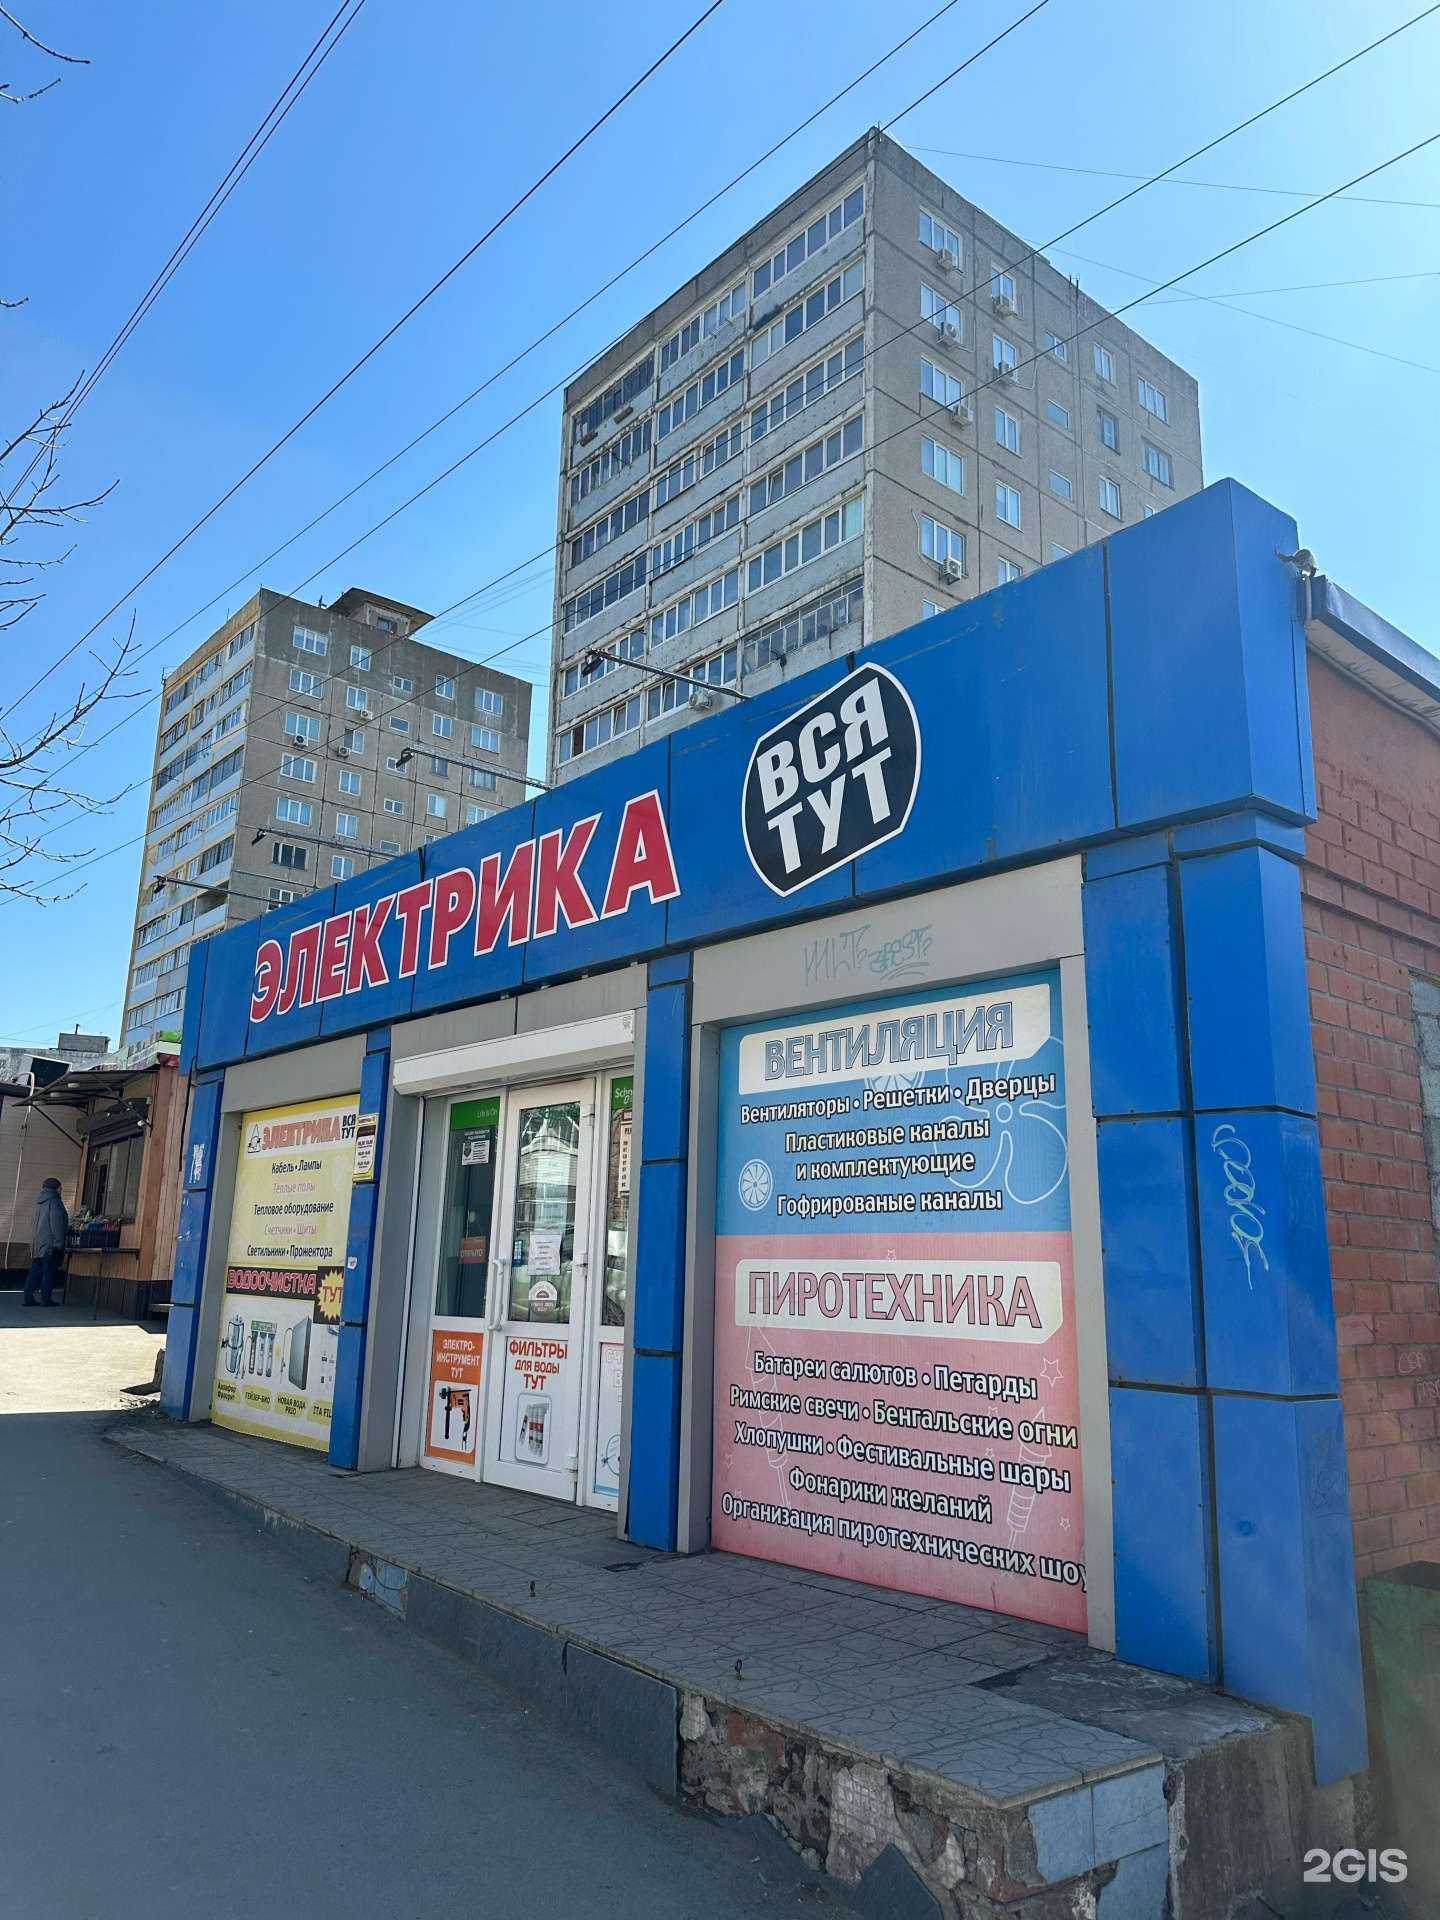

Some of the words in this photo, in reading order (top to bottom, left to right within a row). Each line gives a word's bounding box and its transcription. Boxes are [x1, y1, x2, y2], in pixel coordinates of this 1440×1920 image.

[757, 677, 889, 814] ВСЯ
[768, 746, 892, 874] ТУТ
[249, 788, 682, 1023] ЭЛЕКТРИКА
[764, 1001, 1014, 1080] ВЕНТИЛЯЦИЯ
[740, 1096, 850, 1125] Вентиляторы
[862, 1085, 950, 1111] Решетки
[965, 1072, 1056, 1104] Дверцы
[261, 1115, 341, 1150] ЭЛЕКТРИКА
[341, 1127, 355, 1140] ТУТ
[342, 1113, 356, 1127] ВСЯ
[785, 1124, 905, 1153] Пластиковые
[910, 1118, 991, 1143] каналы
[272, 1162, 294, 1174] Кабель
[298, 1159, 322, 1172] Лампы
[796, 1161, 808, 1181] и
[810, 1151, 975, 1180] комплектующие
[254, 1204, 283, 1216] Тепловое
[284, 1202, 334, 1216] оборудование
[777, 1192, 916, 1219] Гофрированые
[919, 1189, 1003, 1212] каналы
[247, 1245, 286, 1257] Светильники
[290, 1245, 333, 1259] Прожектора
[227, 1269, 317, 1295] ВОДООЧИСТКА
[322, 1286, 342, 1303] ТУТ
[748, 1271, 1043, 1329] ПИРОТЕХНИКА
[436, 1353, 480, 1366] ИНСТРУМЕНТ
[443, 1339, 475, 1352] ЭЛЕКТРО-
[509, 1339, 568, 1359] ФИЛЬТРЫ
[451, 1367, 464, 1379] ТУТ
[523, 1373, 547, 1391] ТУТ
[753, 1351, 827, 1380] Батареи
[829, 1361, 918, 1388] салютов
[933, 1364, 1038, 1402] Петарды
[729, 1385, 801, 1414] Римские
[805, 1393, 860, 1421] свечи
[873, 1400, 1014, 1440] Бенгальские
[1017, 1420, 1079, 1449] огни
[734, 1421, 824, 1457] Хлопушки
[836, 1435, 995, 1480] Фестивальные
[999, 1461, 1072, 1494] шары
[788, 1466, 887, 1505] Фонарики
[891, 1487, 993, 1524] желаний
[721, 1493, 835, 1536] Организация
[837, 1517, 1035, 1576] пиротехнических
